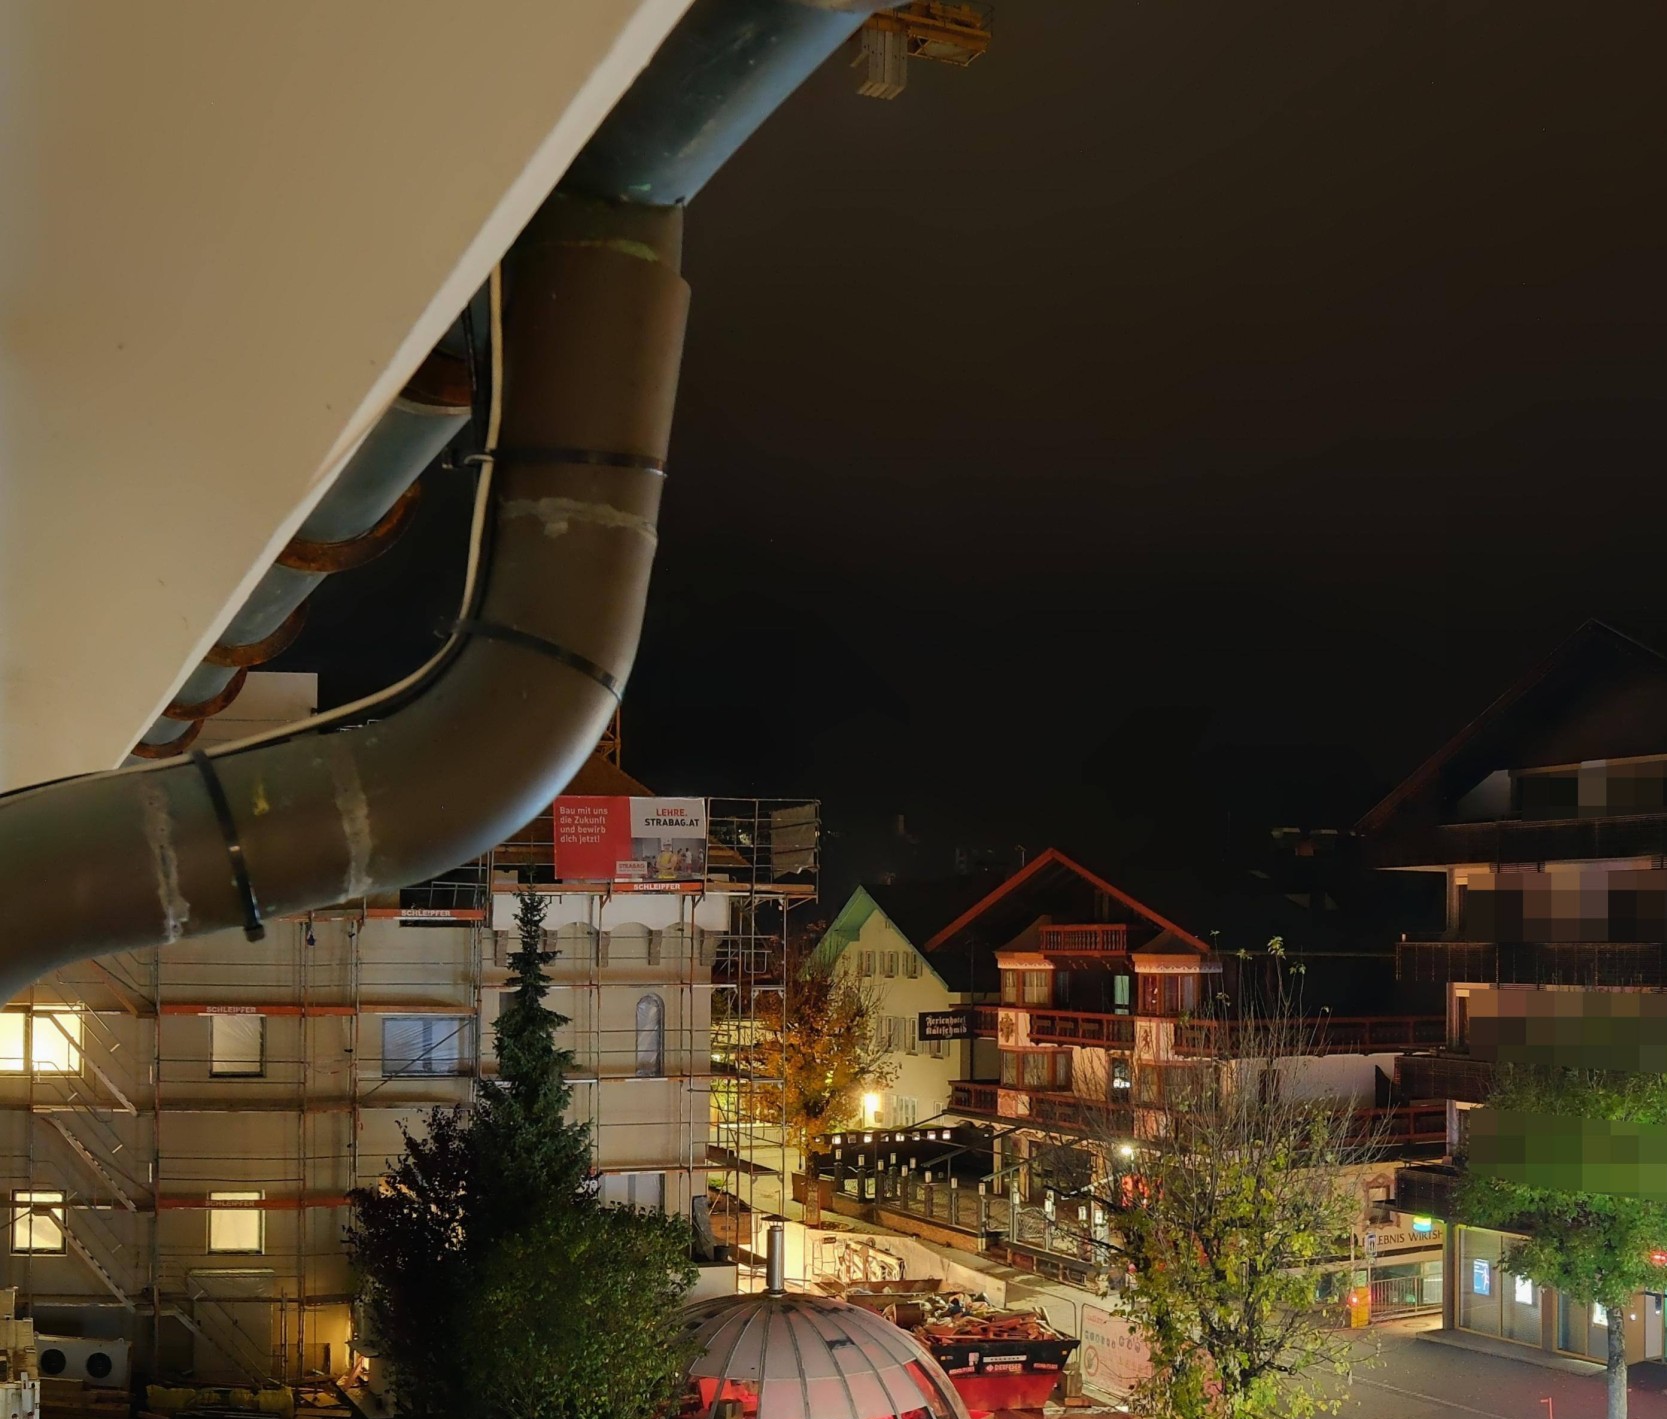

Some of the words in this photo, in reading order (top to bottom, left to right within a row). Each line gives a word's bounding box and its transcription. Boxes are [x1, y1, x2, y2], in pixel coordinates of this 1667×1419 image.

[560, 806, 575, 815] Bau
[578, 806, 591, 815] mit
[656, 808, 688, 817] LEHRE.
[560, 816, 572, 824] die
[574, 816, 606, 824] Zukunft
[644, 818, 700, 827] STRABAG.AT
[560, 825, 575, 833] und
[577, 825, 606, 833] bewirb
[560, 835, 577, 843] dich
[579, 835, 601, 844] jetzt!
[401, 909, 451, 917] SCHLEIPFER
